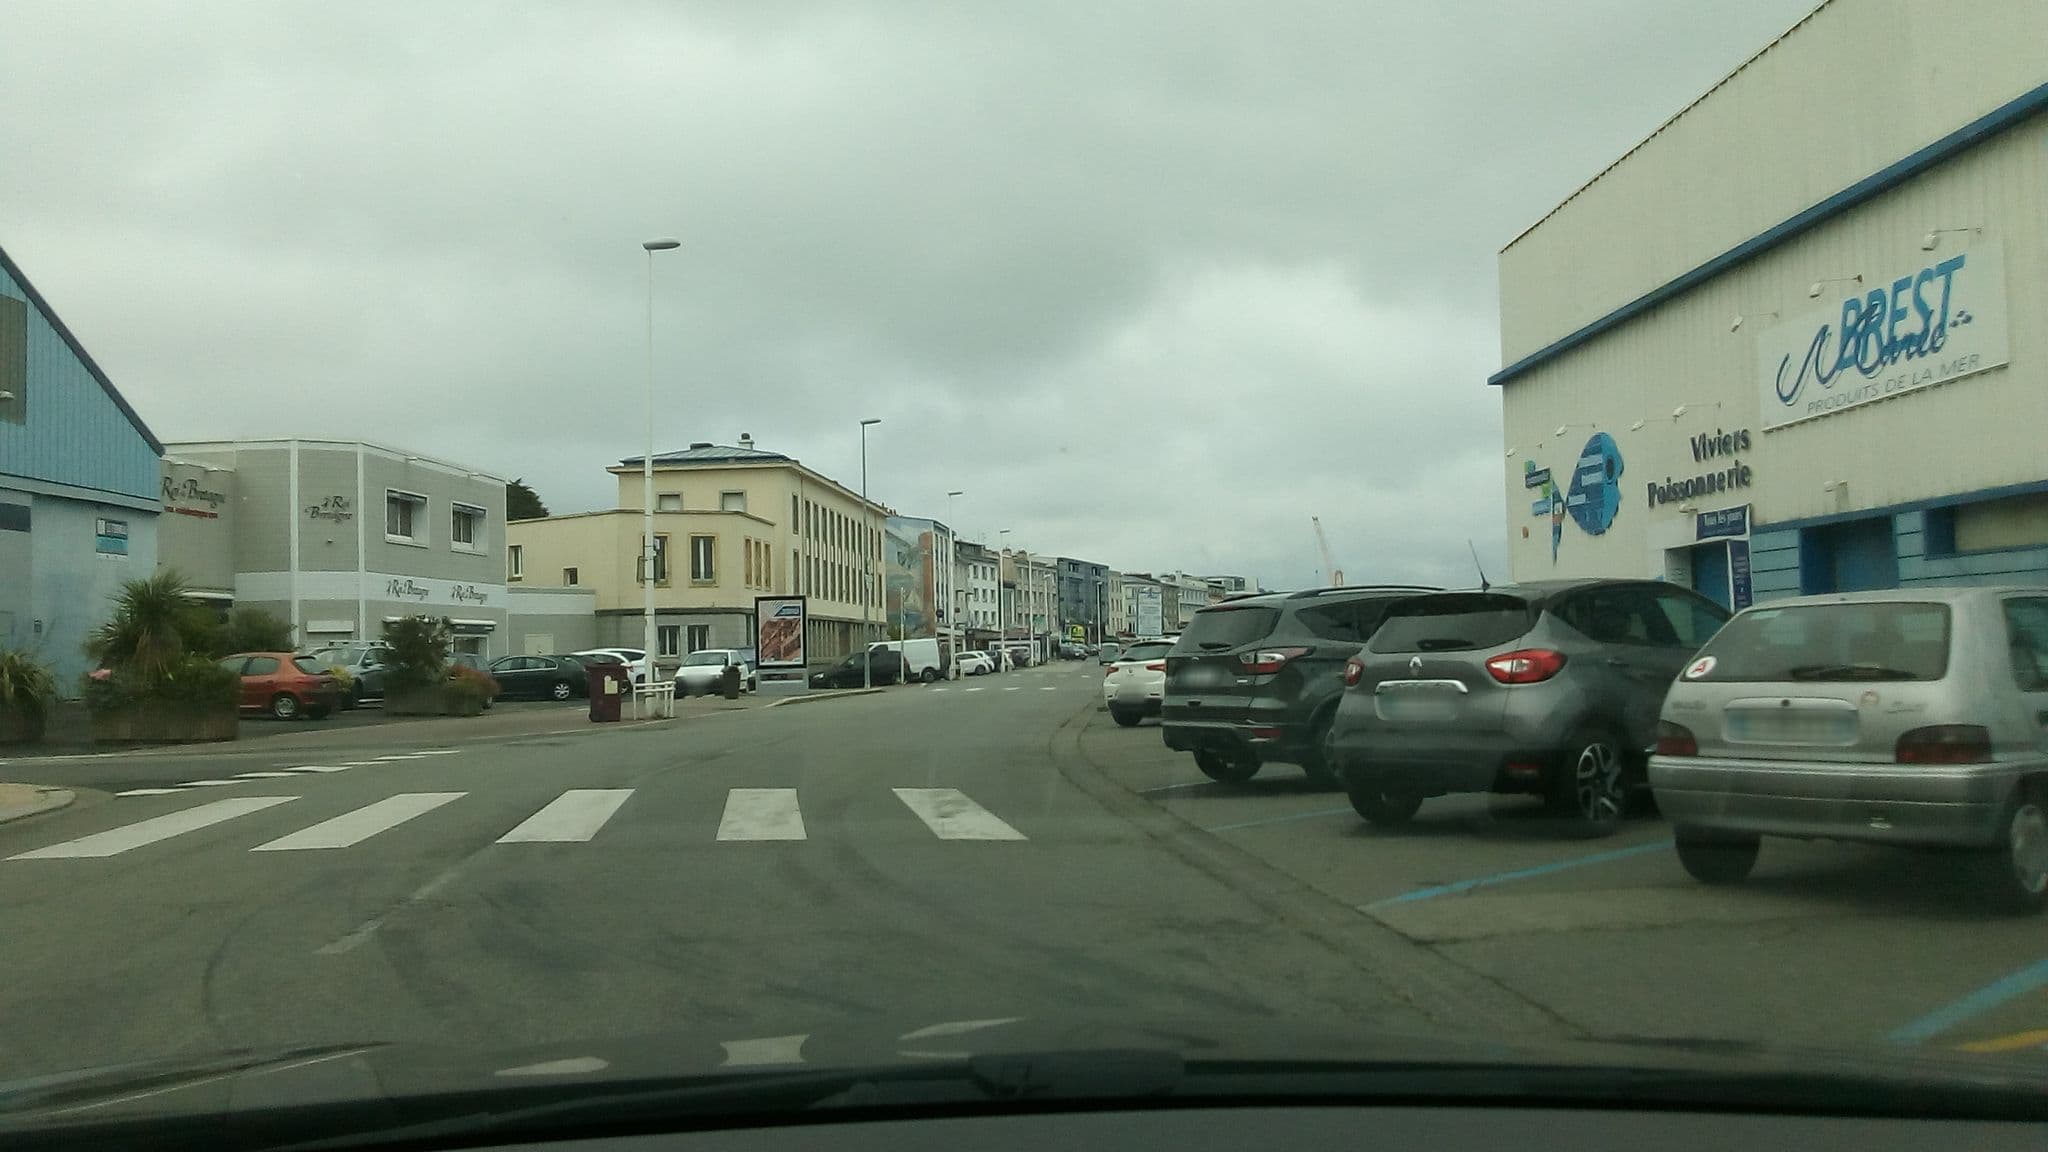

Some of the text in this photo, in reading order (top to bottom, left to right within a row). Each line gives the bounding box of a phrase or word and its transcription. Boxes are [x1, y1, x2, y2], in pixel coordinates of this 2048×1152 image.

[1839, 254, 1966, 371] BREST
[1807, 353, 1981, 414] PRODUITS DE LA MER
[1690, 427, 1751, 462] Viviers
[1647, 459, 1752, 508] Poissonnerie
